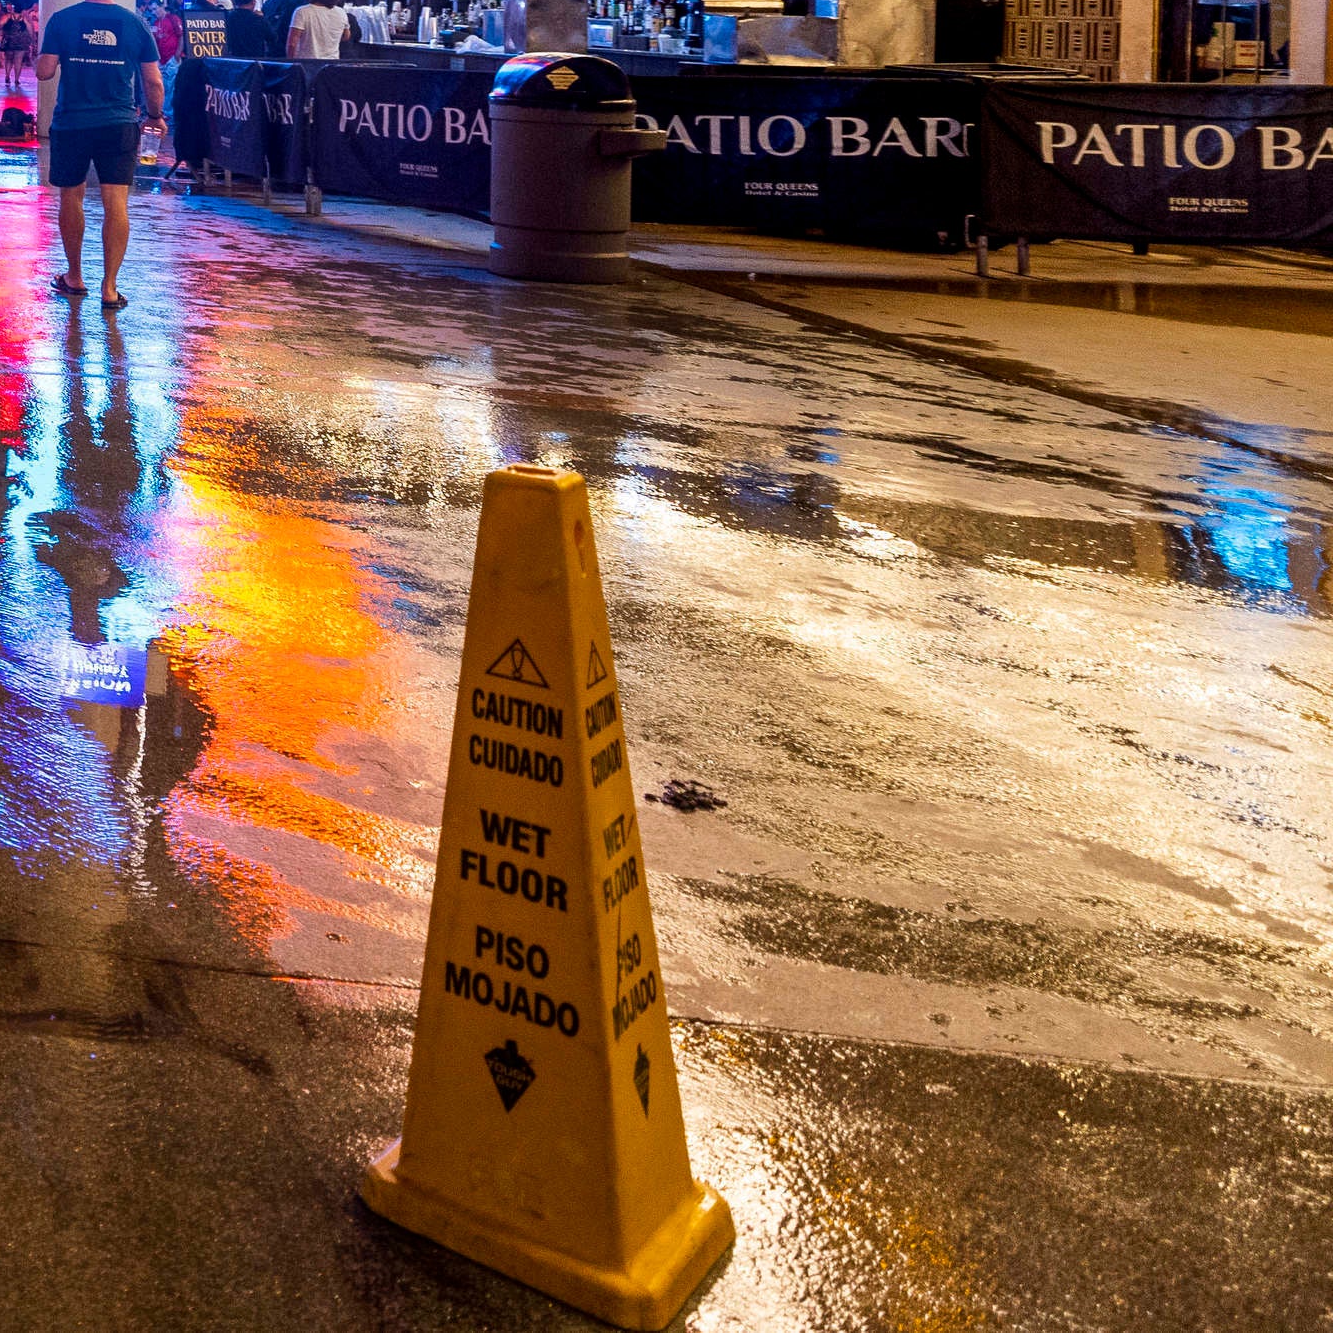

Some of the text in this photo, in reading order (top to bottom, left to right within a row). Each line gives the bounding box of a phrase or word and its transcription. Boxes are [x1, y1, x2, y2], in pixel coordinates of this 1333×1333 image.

[186, 19, 226, 28] PATIO BAR
[188, 31, 226, 44] ENTER
[193, 45, 225, 58] ONLY
[339, 98, 491, 145] PATIO BA
[825, 115, 966, 157] BAR
[1035, 121, 1333, 171] PATIO BA
[1169, 197, 1249, 206] FOUR QUEENS
[471, 687, 564, 740] CAUTION
[585, 691, 617, 740] CAUTION
[468, 734, 564, 788] CUIDADO
[591, 738, 622, 789] CUIDADO
[479, 807, 551, 860] WET
[603, 813, 626, 861] WET
[460, 848, 569, 913] FLOOR
[603, 855, 639, 914] FLOOR
[475, 925, 551, 979] PISO
[616, 933, 642, 977] PISO
[444, 960, 580, 1038] MOJADO
[612, 970, 657, 1042] MOJADO
